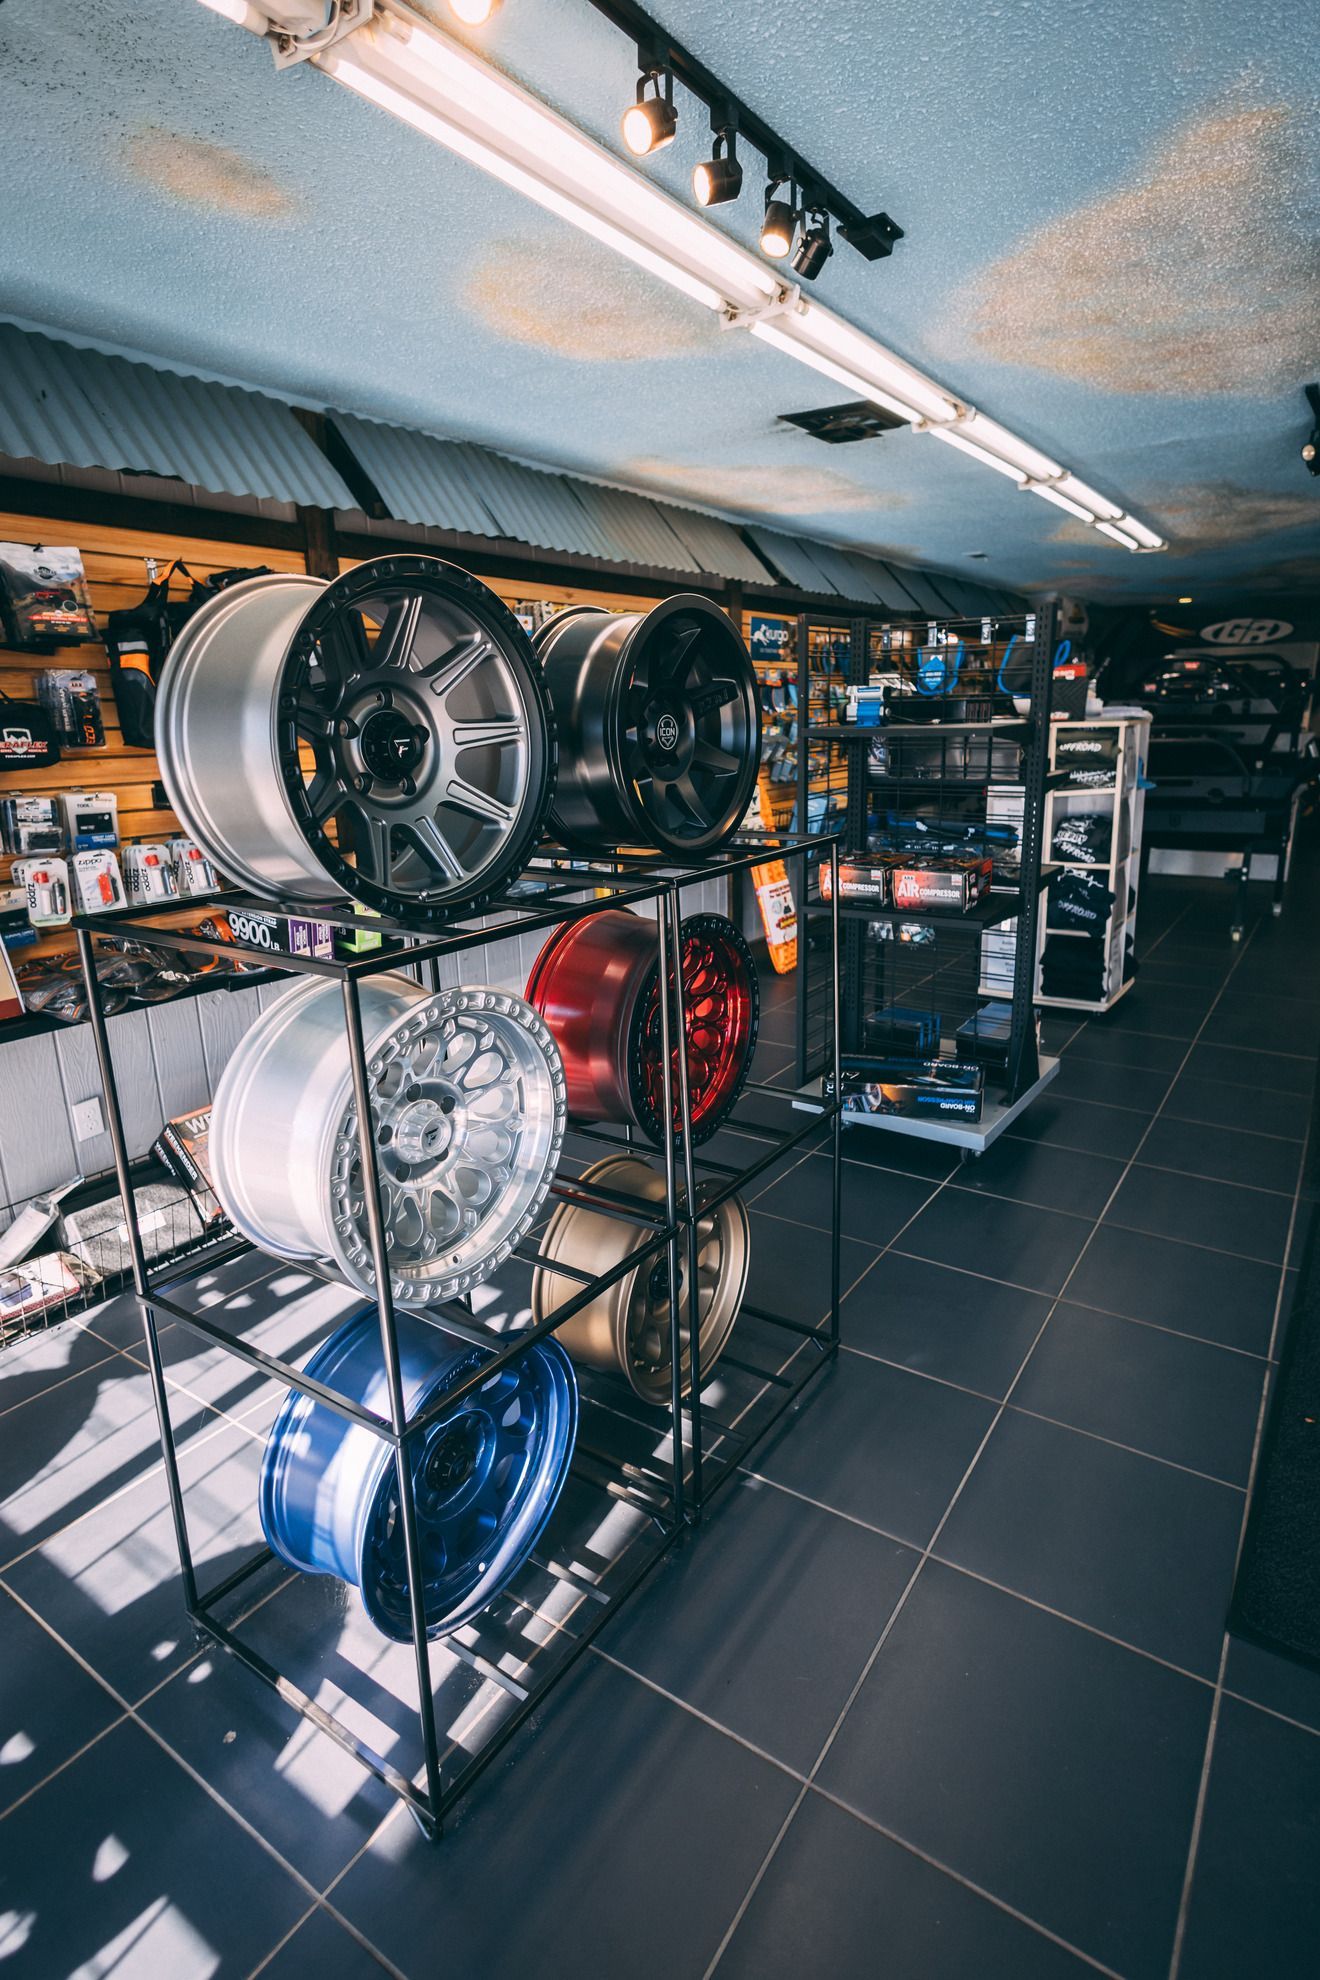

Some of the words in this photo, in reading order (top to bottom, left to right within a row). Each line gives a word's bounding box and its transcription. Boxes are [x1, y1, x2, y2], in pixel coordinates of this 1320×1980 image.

[659, 727, 676, 737] ICON
[843, 882, 880, 893] COMPRESSOR
[898, 880, 920, 898] AIR
[919, 889, 960, 899] COMPRESSOR
[228, 913, 271, 948] 9900
[940, 1102, 976, 1111] ON-BOARD
[164, 1127, 198, 1181] WEEKENDER
